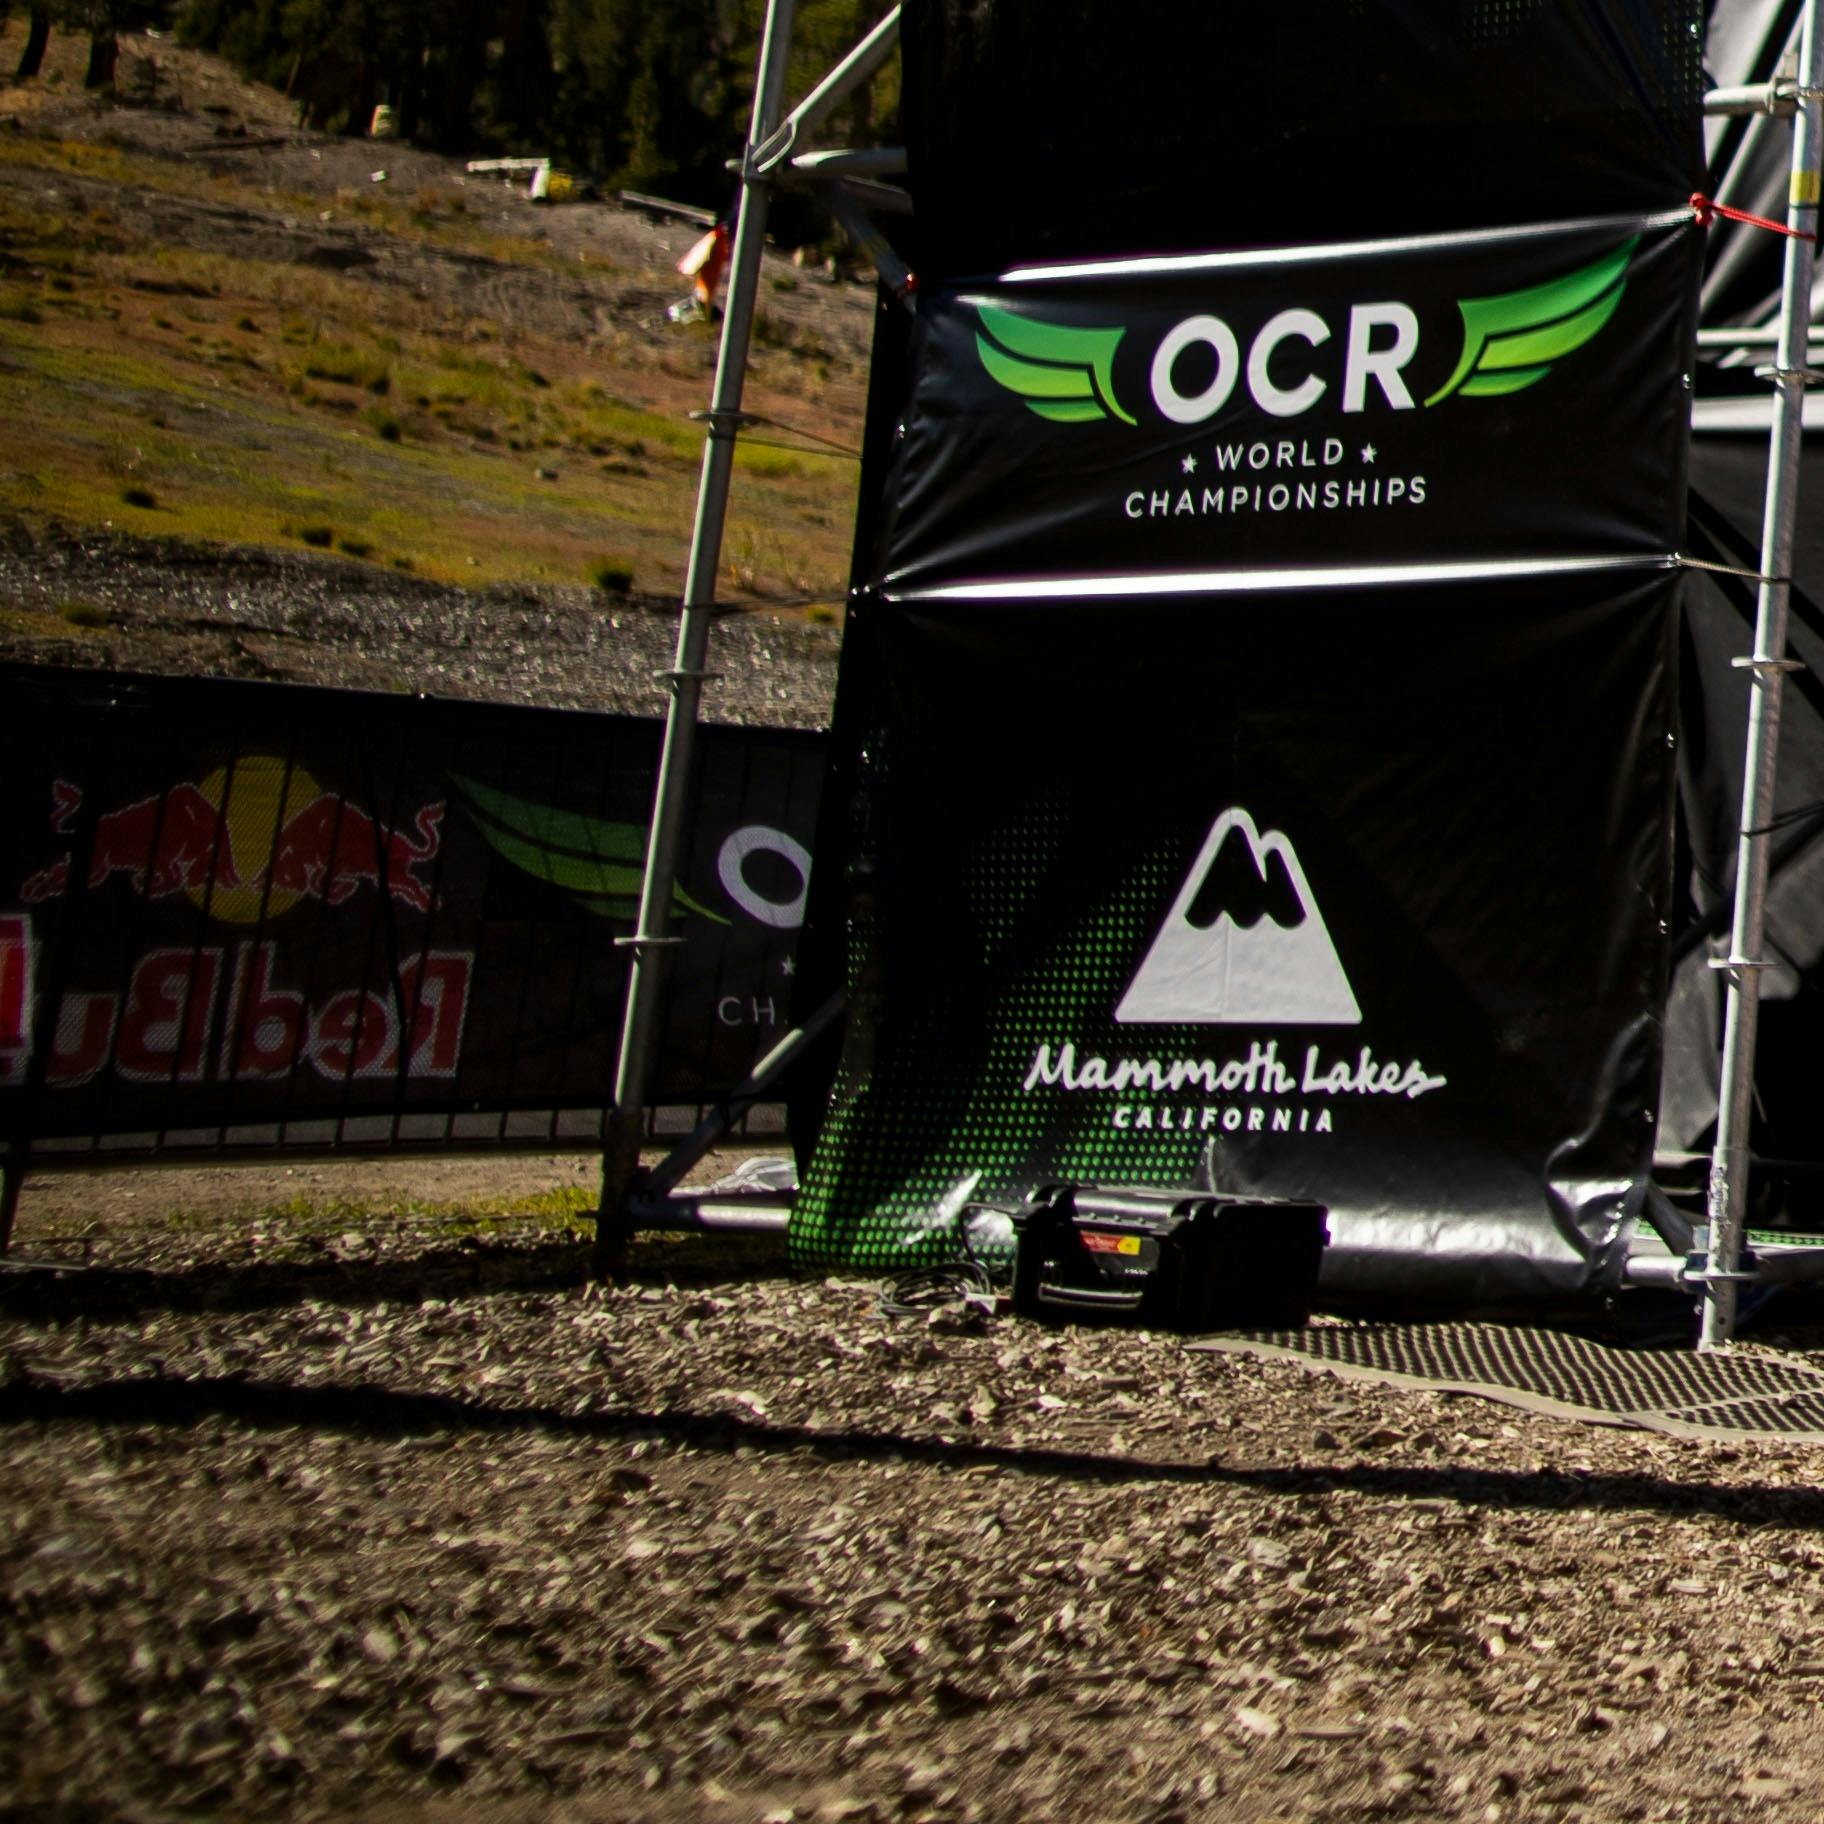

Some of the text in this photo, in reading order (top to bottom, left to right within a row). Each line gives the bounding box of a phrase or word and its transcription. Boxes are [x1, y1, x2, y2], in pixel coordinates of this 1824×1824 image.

[1149, 301, 1420, 426] OCR
[1215, 438, 1345, 472] WORLD
[1124, 476, 1427, 519] CHAMPIONSHIPS
[1024, 1042, 1447, 1098] Mammoth Lakes
[1113, 1106, 1333, 1133] CALIFORNIA
